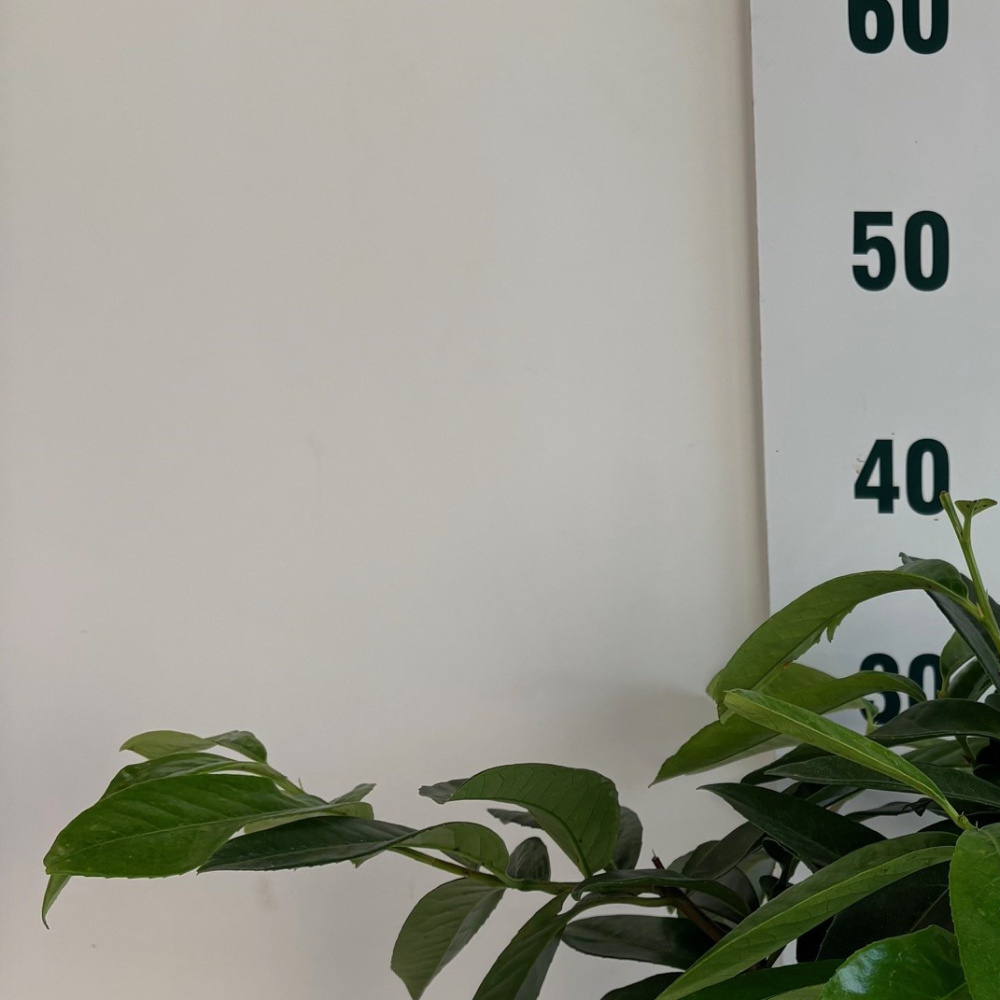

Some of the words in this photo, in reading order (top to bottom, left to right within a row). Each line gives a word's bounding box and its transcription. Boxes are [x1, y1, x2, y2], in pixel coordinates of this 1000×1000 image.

[848, 0, 949, 54] 60
[852, 210, 950, 292] 50
[853, 438, 950, 516] 40
